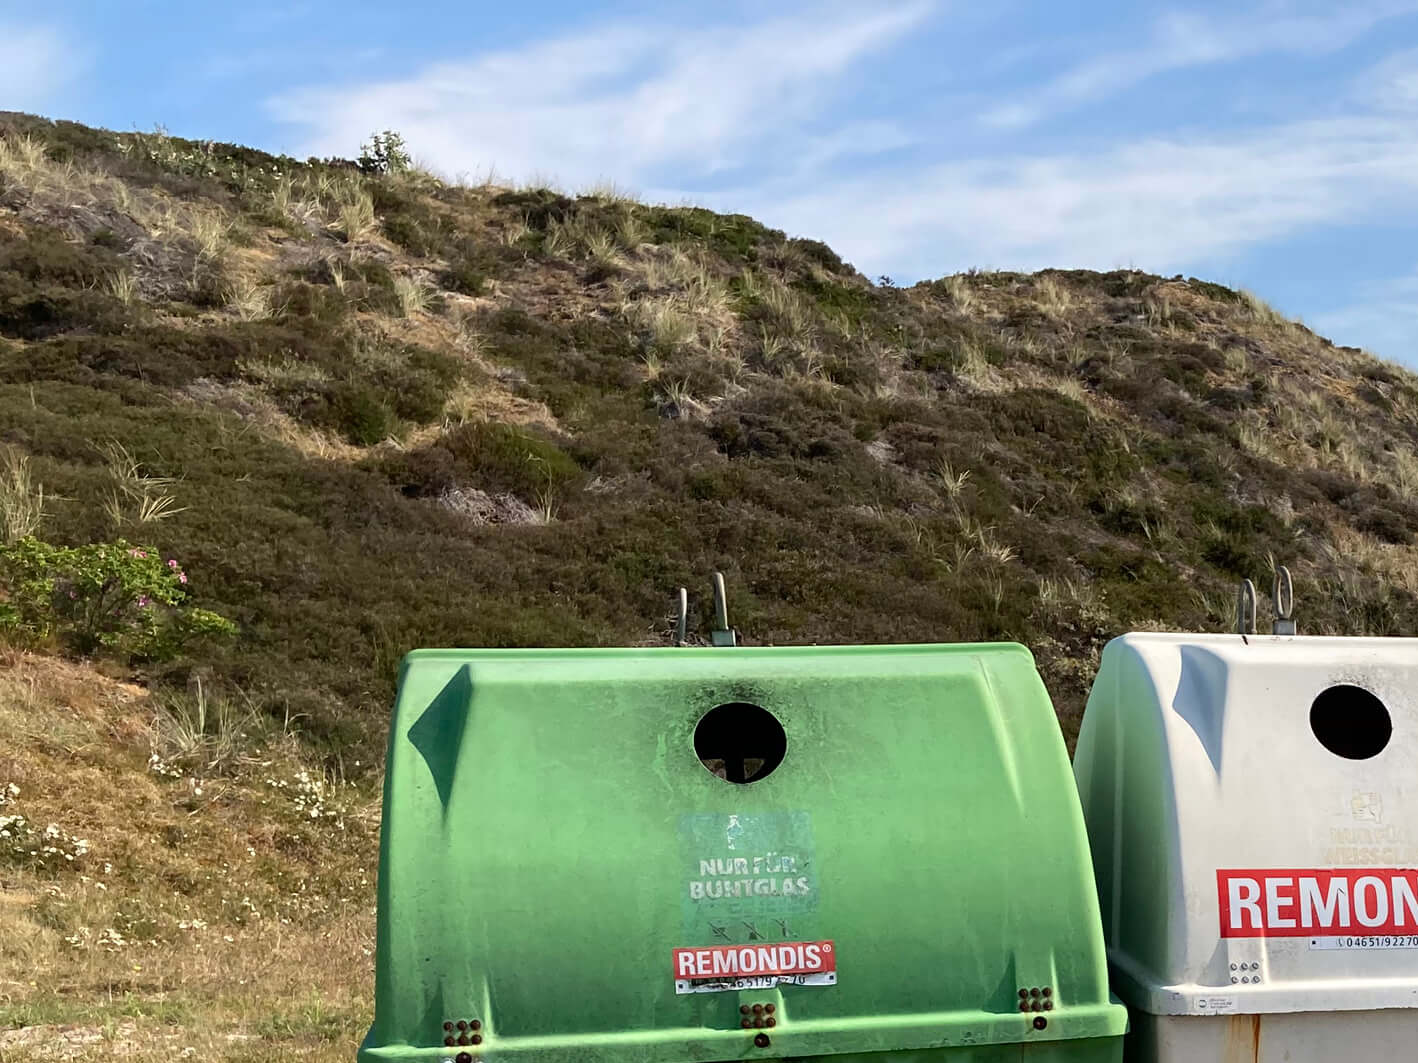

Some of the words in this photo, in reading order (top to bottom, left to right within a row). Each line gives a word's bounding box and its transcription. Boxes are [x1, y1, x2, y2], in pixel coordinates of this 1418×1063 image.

[700, 857, 748, 876] NUR
[753, 852, 797, 874] FÜR
[689, 876, 811, 899] BUNTGLAS
[1346, 936, 1418, 947] 04651/92270
